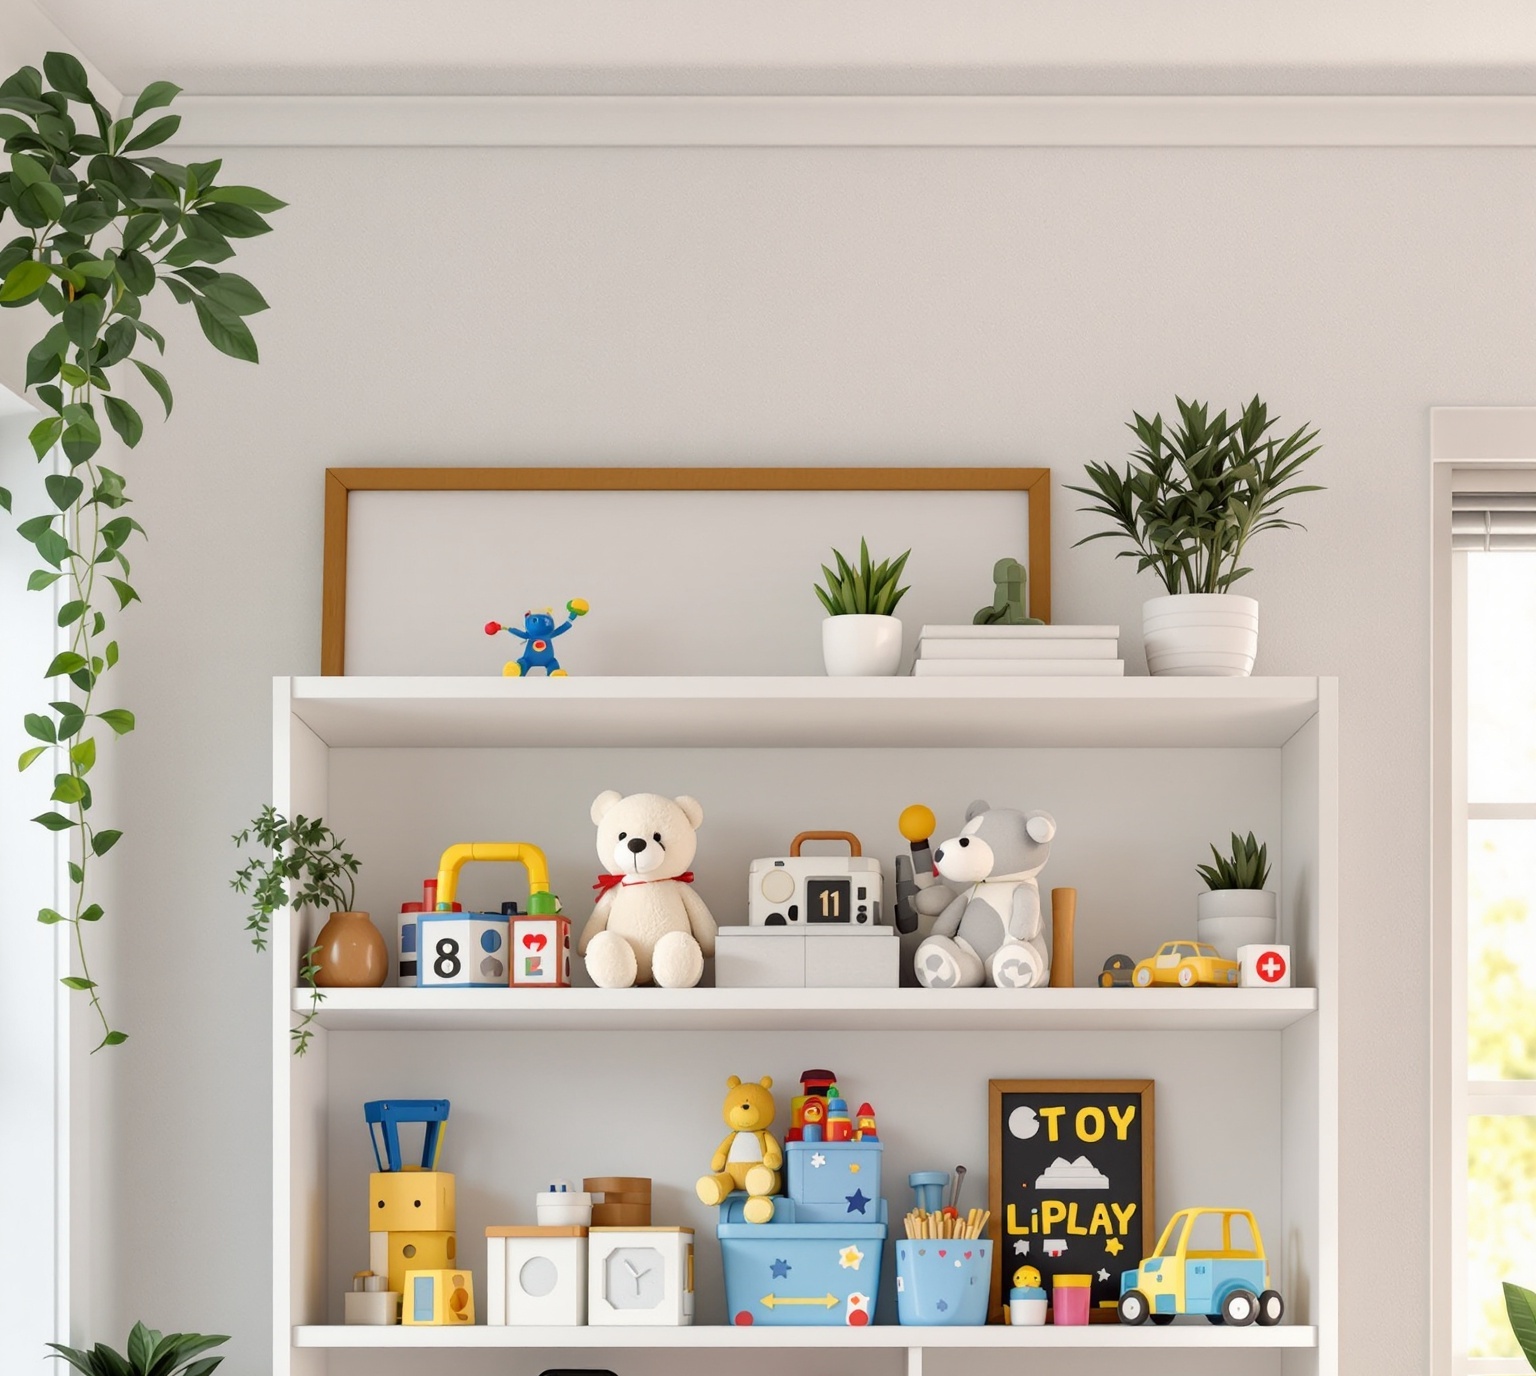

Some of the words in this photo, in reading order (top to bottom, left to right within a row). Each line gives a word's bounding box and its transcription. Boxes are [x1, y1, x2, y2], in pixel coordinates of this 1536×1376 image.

[819, 889, 840, 917] 11
[433, 937, 462, 979] 8
[1039, 1105, 1136, 1143] TOY
